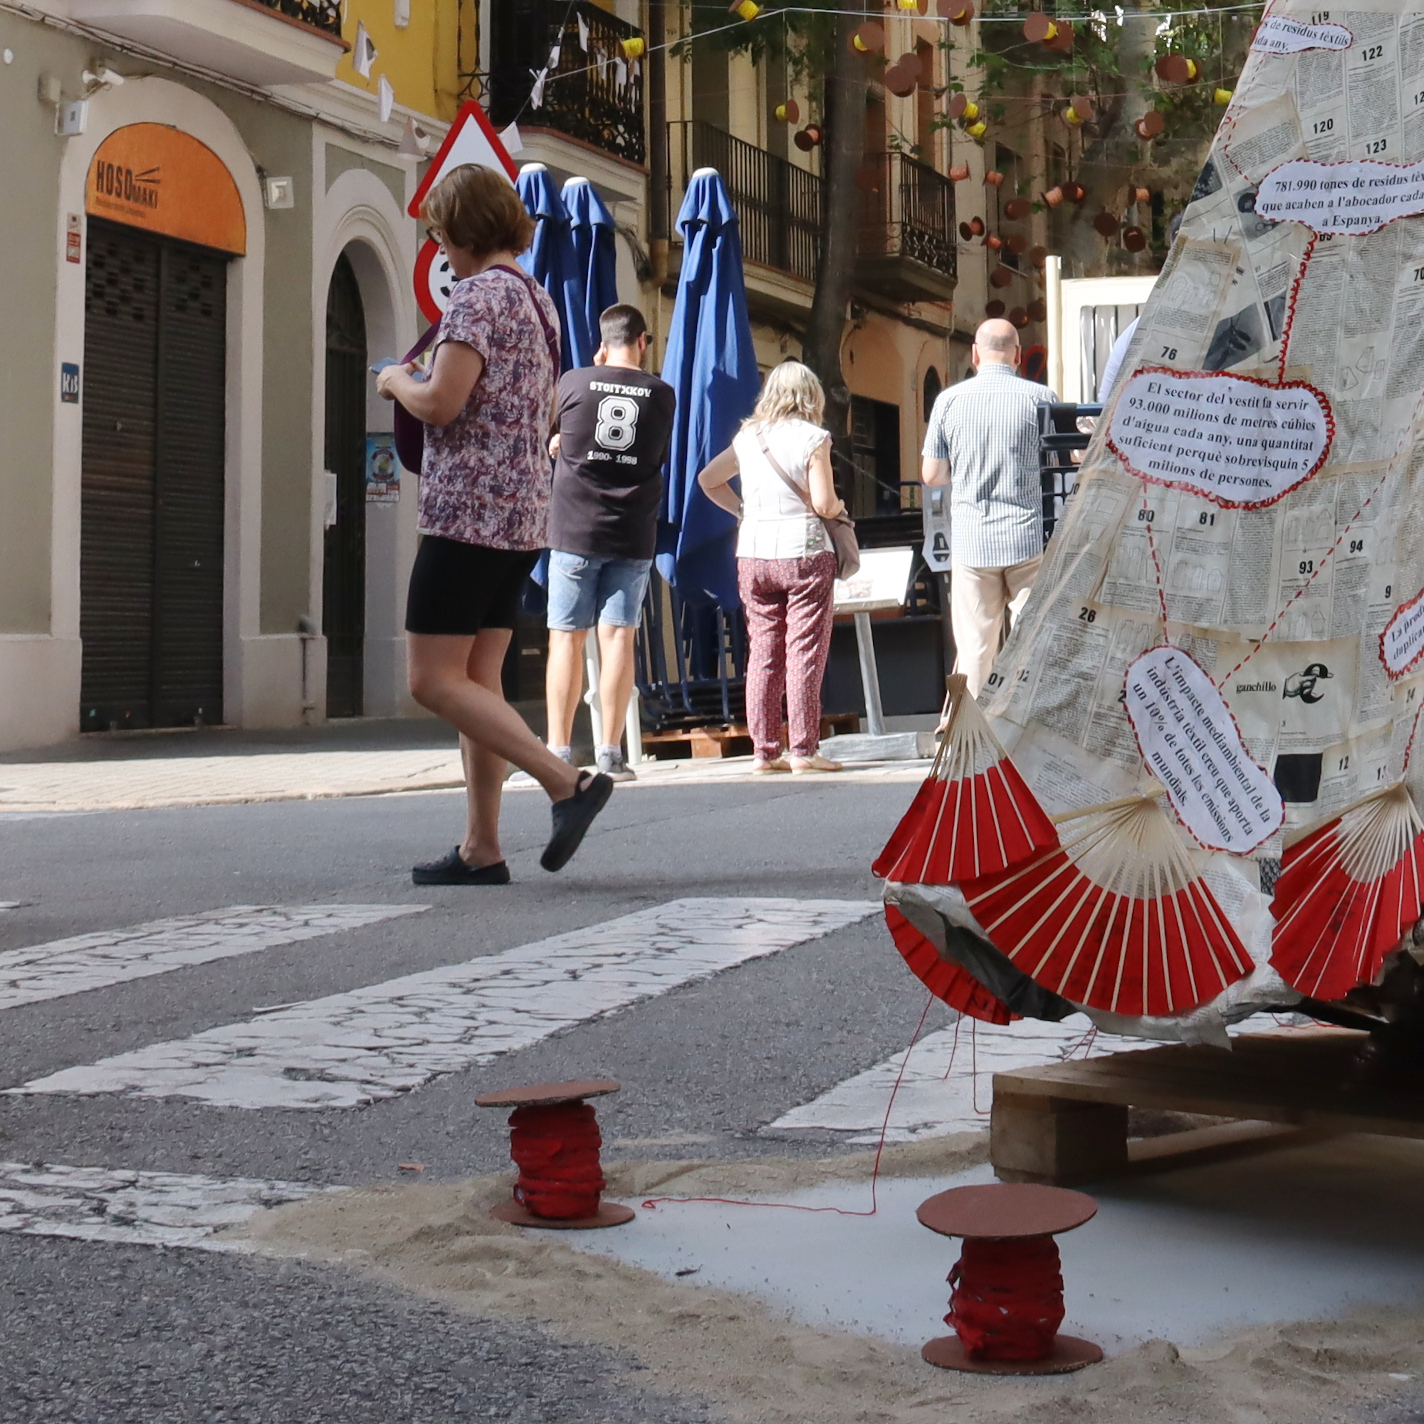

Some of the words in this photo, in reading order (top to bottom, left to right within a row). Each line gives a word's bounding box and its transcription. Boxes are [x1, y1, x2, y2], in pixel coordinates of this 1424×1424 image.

[1282, 24, 1316, 38] residus
[1362, 46, 1383, 62] 122
[1313, 119, 1333, 134] 120
[1366, 139, 1387, 154] 123
[1275, 180, 1316, 192] 781.990
[1320, 178, 1348, 190] tones
[1352, 177, 1365, 188] de
[1369, 174, 1407, 187] residus
[1262, 201, 1282, 213] que
[1285, 197, 1324, 210] acaben
[1328, 200, 1333, 208] a
[1338, 195, 1398, 208] l'abocador
[1400, 190, 1424, 202] cada
[1322, 217, 1328, 227] a
[1332, 215, 1383, 228] Espanya.
[1160, 346, 1177, 361] 76
[1147, 382, 1162, 394] El
[1164, 388, 1203, 402] sector
[1206, 392, 1225, 404] del
[1228, 396, 1260, 408] vestit
[1262, 397, 1272, 408] fa
[1275, 399, 1309, 410] servir
[1129, 398, 1170, 414] 93.000
[1173, 408, 1219, 423] milions
[1223, 413, 1237, 425] de
[1241, 417, 1277, 428] metres
[1281, 417, 1316, 431] cúbics
[595, 395, 639, 451] 8
[1122, 416, 1169, 434] d'aigua
[1173, 428, 1203, 439] cada
[1207, 433, 1232, 446] any,
[1237, 437, 1258, 447] una
[1261, 438, 1314, 451] quantitat
[587, 451, 612, 461] 1990-
[616, 454, 637, 465] 1998
[1118, 435, 1173, 453] suficient
[1175, 446, 1222, 463] perquè
[1225, 454, 1298, 471] sobrevisquin
[1301, 459, 1309, 470] 5
[1148, 460, 1195, 476] milions
[1200, 469, 1215, 481] de
[1217, 474, 1272, 488] persones.
[1138, 510, 1155, 523] 80
[1199, 512, 1215, 526] 81
[1349, 540, 1363, 553] 94
[1298, 561, 1314, 574] 93
[1078, 607, 1096, 623] 26
[1391, 627, 1402, 642] La
[1236, 683, 1276, 694] ganchillo
[1164, 656, 1205, 716] L'impacte
[1202, 715, 1257, 795] mediambiental
[1251, 793, 1263, 810] de
[1260, 808, 1271, 824] la
[1146, 666, 1185, 723] indústria
[1182, 722, 1207, 752] tèxtil
[1201, 753, 1219, 778] creu
[1215, 777, 1232, 798] que
[1228, 797, 1253, 836] aporta
[1133, 683, 1147, 701] un
[1145, 702, 1168, 732] 10%
[1164, 733, 1177, 748] de
[1175, 748, 1194, 776] totes
[1191, 774, 1204, 792] les
[1201, 793, 1233, 843] emissions
[1339, 756, 1349, 771] 12
[1152, 751, 1188, 807] mundials.
